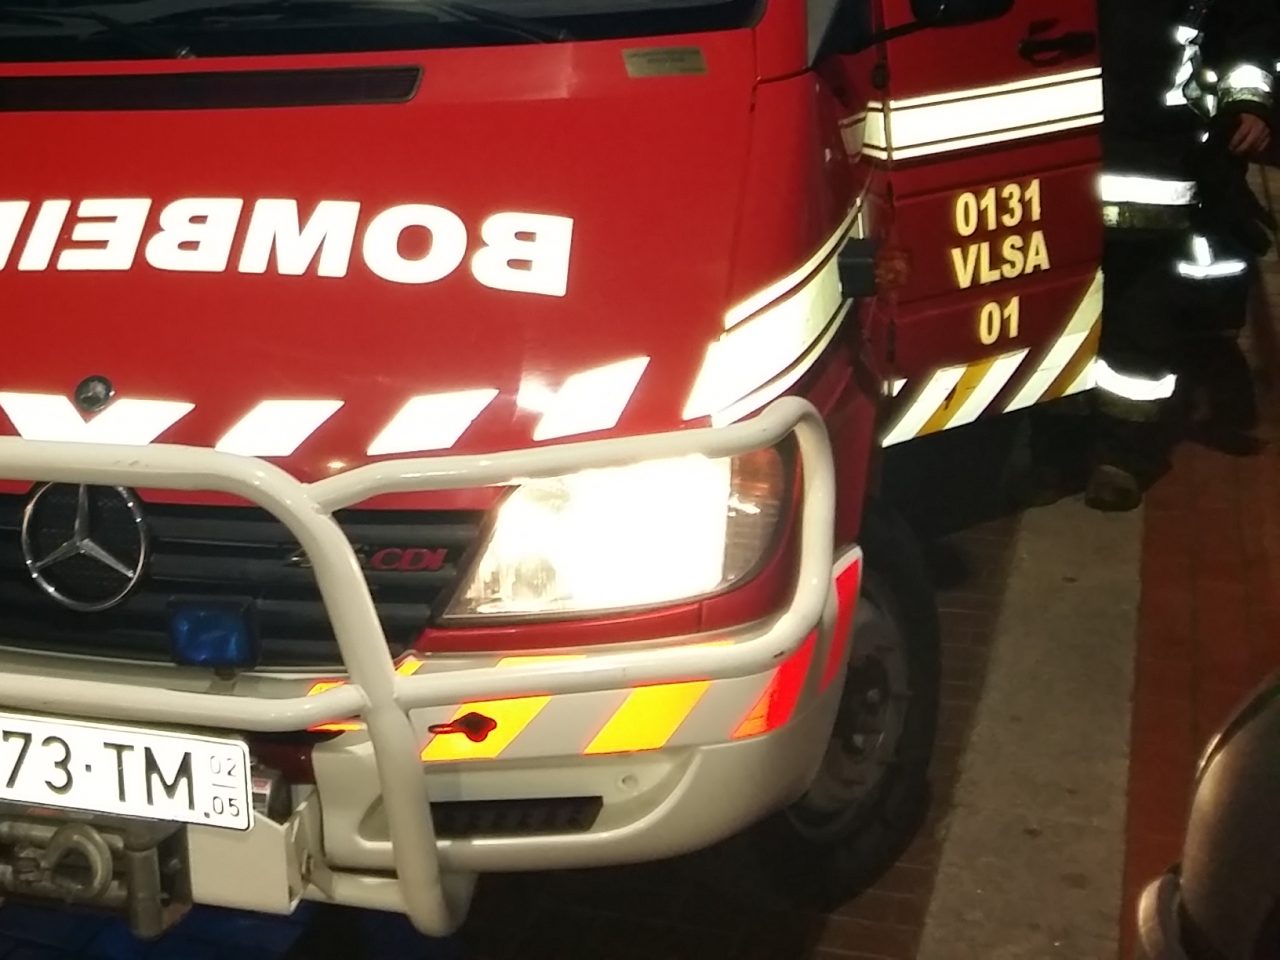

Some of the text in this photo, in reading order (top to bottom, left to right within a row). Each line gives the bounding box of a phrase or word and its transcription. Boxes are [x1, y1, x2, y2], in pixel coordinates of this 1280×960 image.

[955, 178, 1042, 237] 0131
[951, 230, 1051, 289] VLSA
[979, 295, 1020, 345] 01
[370, 547, 448, 572] CDI
[209, 755, 237, 777] 02
[212, 795, 241, 818] 05
